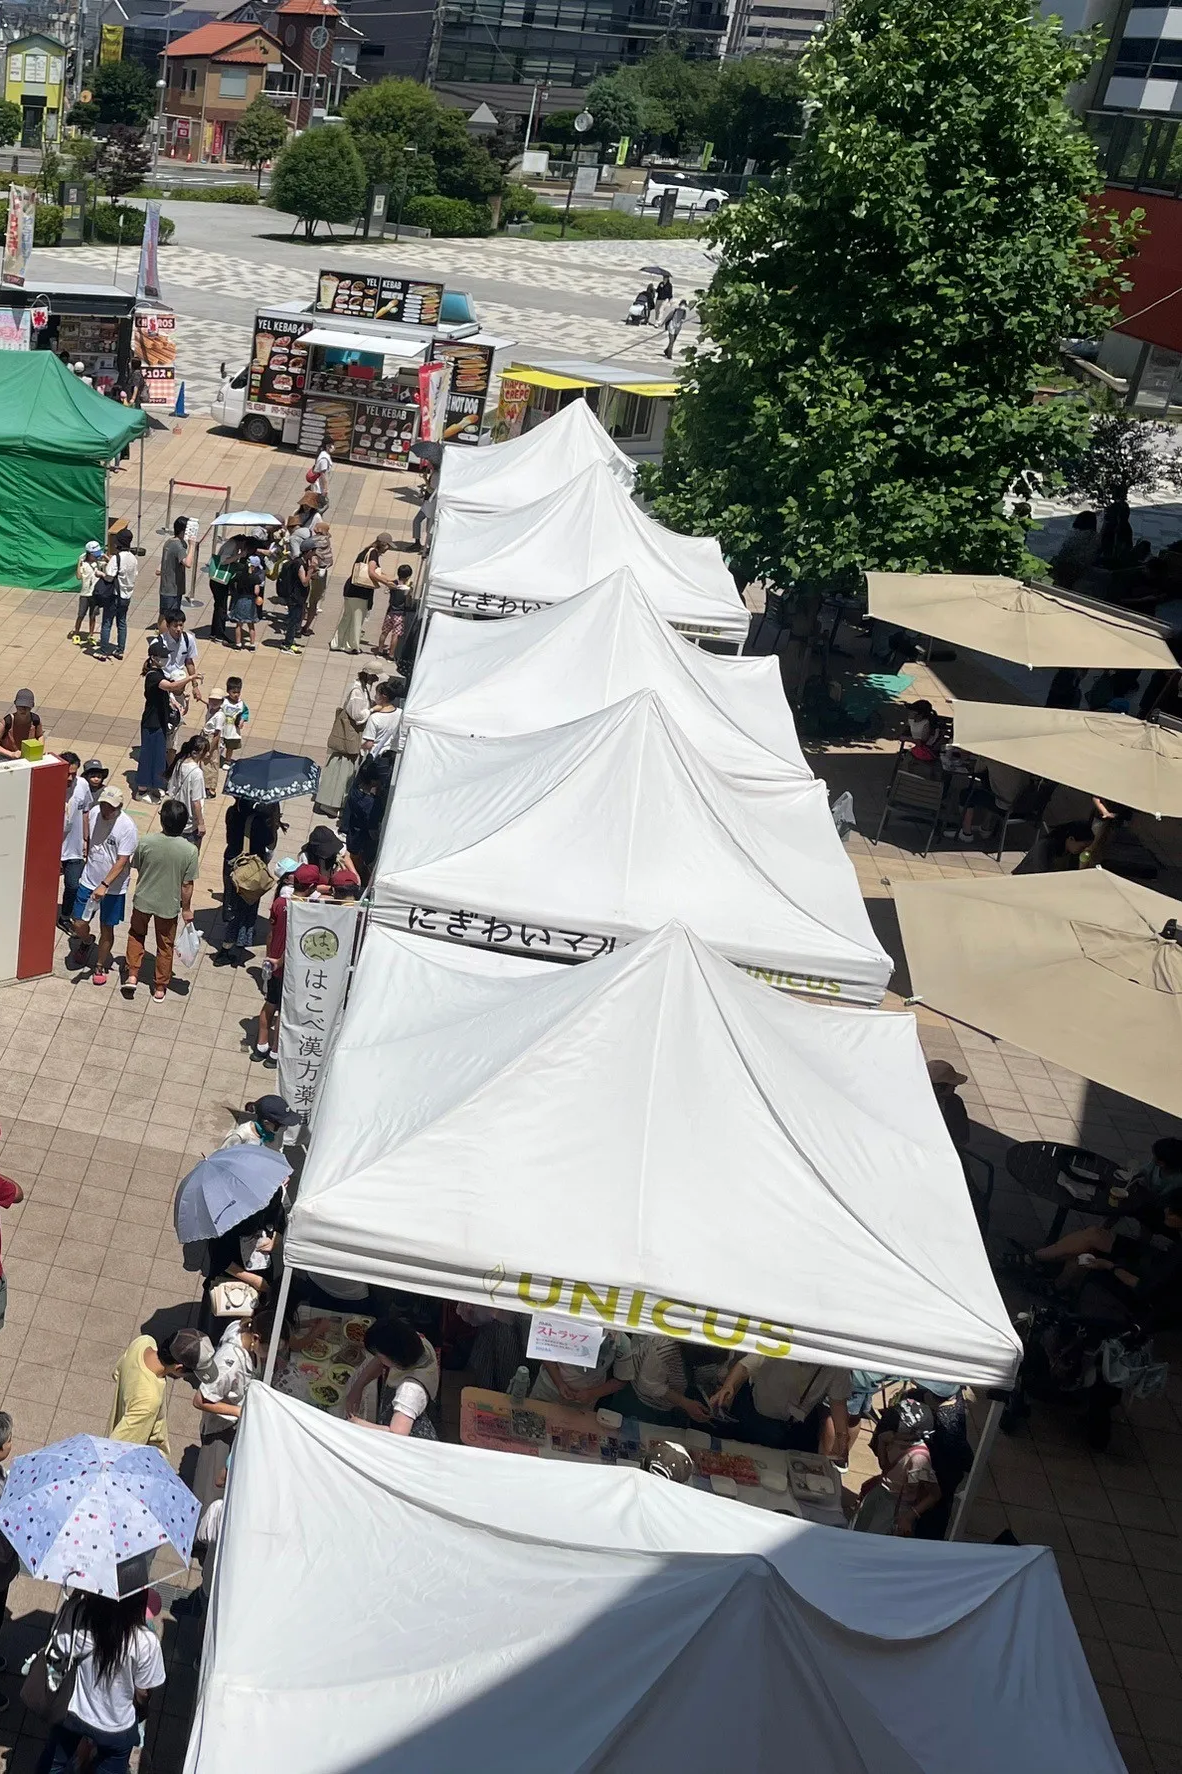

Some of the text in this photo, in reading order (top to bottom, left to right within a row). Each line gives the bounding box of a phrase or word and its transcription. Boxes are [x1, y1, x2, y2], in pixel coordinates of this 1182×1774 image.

[367, 278, 402, 290] YEL KEBAB
[136, 316, 173, 328] CHROS
[258, 319, 298, 334] YEL KEBAB
[141, 369, 166, 378] チュロス
[505, 389, 530, 400] CREPE
[366, 405, 407, 420] YEL KEBAB
[450, 395, 465, 413] HOT
[464, 397, 479, 415] DOG
[451, 590, 554, 615] にぎわい
[409, 904, 630, 957] にぎわいマル
[293, 968, 328, 1127] はこべ漢方薬局
[517, 1272, 795, 1358] UNICUS
[537, 1326, 590, 1343] ストラップ
